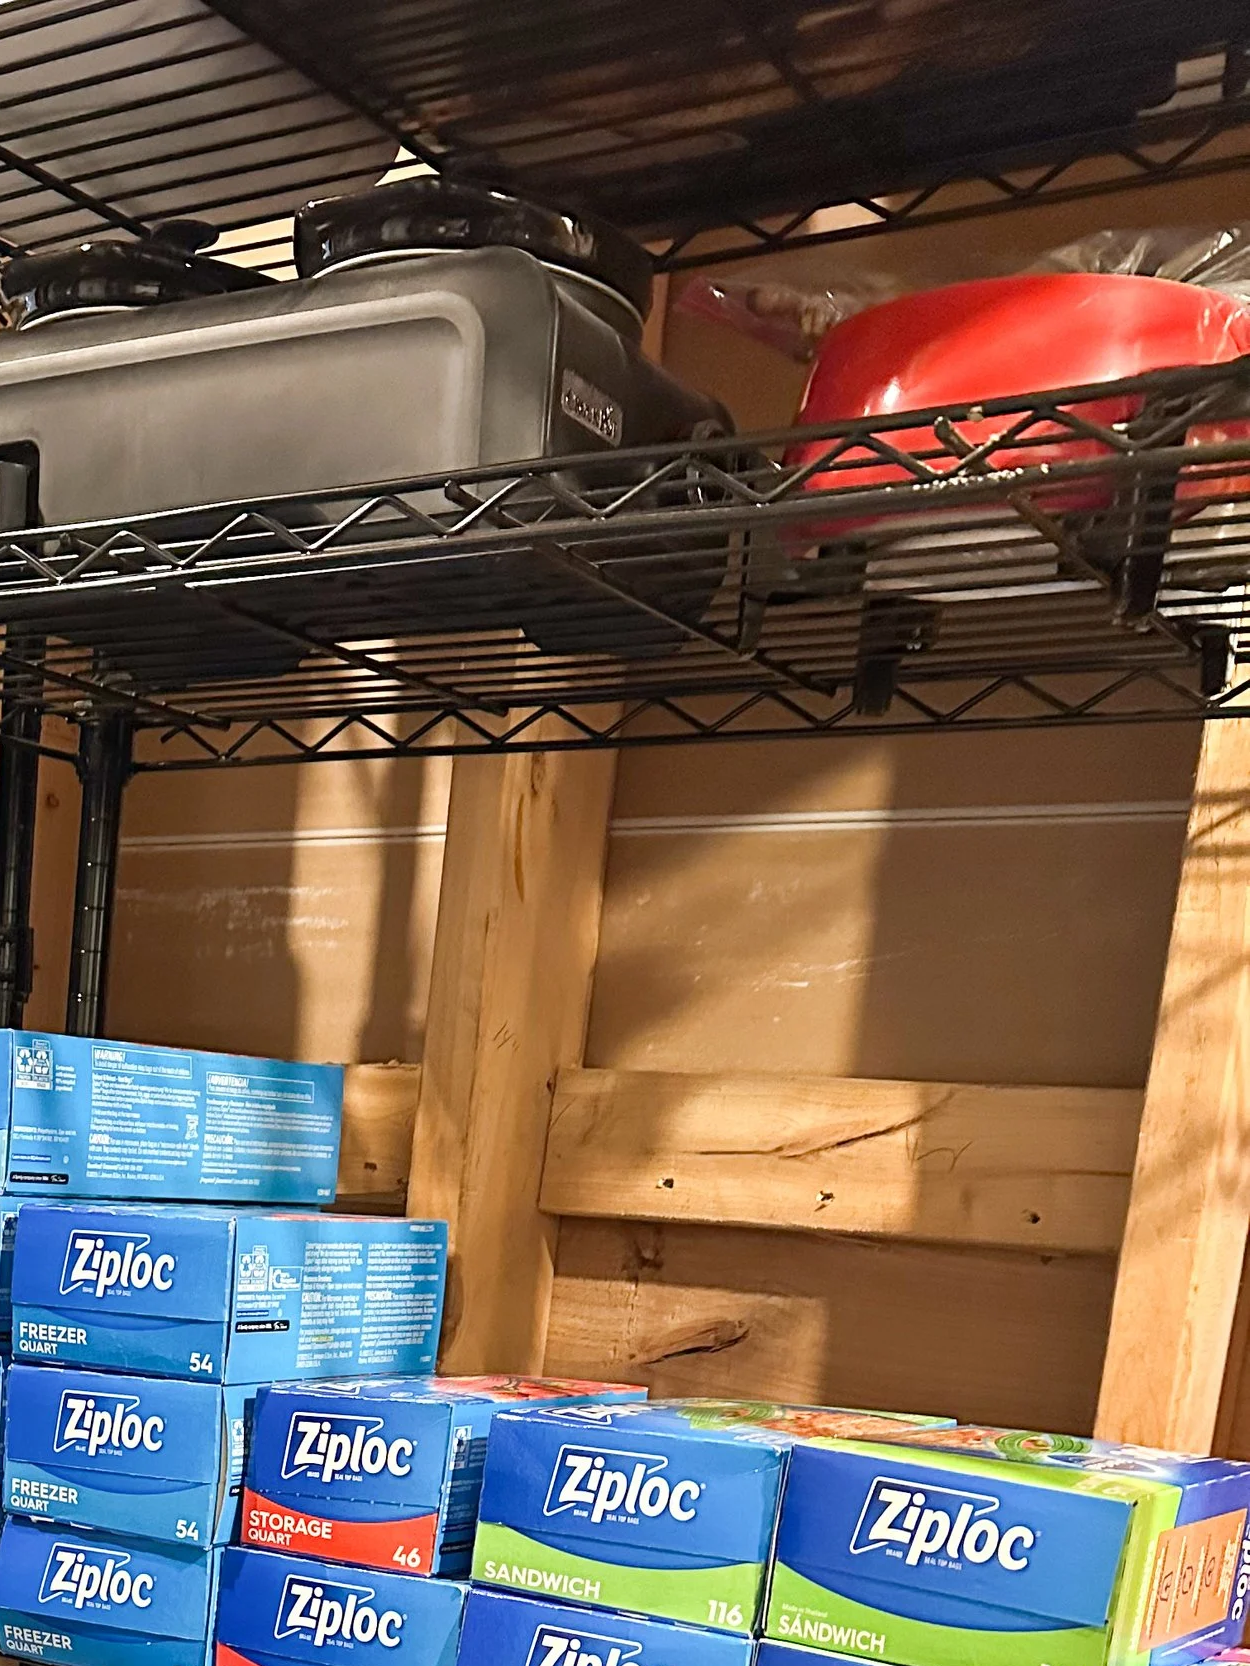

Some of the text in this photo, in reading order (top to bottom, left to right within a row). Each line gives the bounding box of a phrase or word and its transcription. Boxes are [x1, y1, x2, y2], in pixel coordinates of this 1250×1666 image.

[70, 1236, 176, 1299] Ziploc
[19, 1320, 88, 1346] FREEZER
[18, 1339, 58, 1356] QUART
[188, 1351, 214, 1374] 54
[63, 1397, 165, 1457] Ziploc
[293, 1420, 414, 1483] Ziploc
[10, 1477, 79, 1505] FREEZER
[559, 1453, 700, 1524] Ziploc
[10, 1495, 50, 1513] QUART
[174, 1519, 199, 1542] 54
[247, 1528, 293, 1547] QUART
[248, 1509, 333, 1540] STORAGE
[868, 1487, 1036, 1571] Ziploc
[392, 1544, 422, 1568] 46
[49, 1551, 154, 1610] Ziploc
[483, 1559, 602, 1600] SANDWICH
[286, 1583, 403, 1648] Ziploc
[706, 1599, 744, 1626] 116
[3, 1624, 73, 1651] FREEZER
[5, 1639, 45, 1657] QUART
